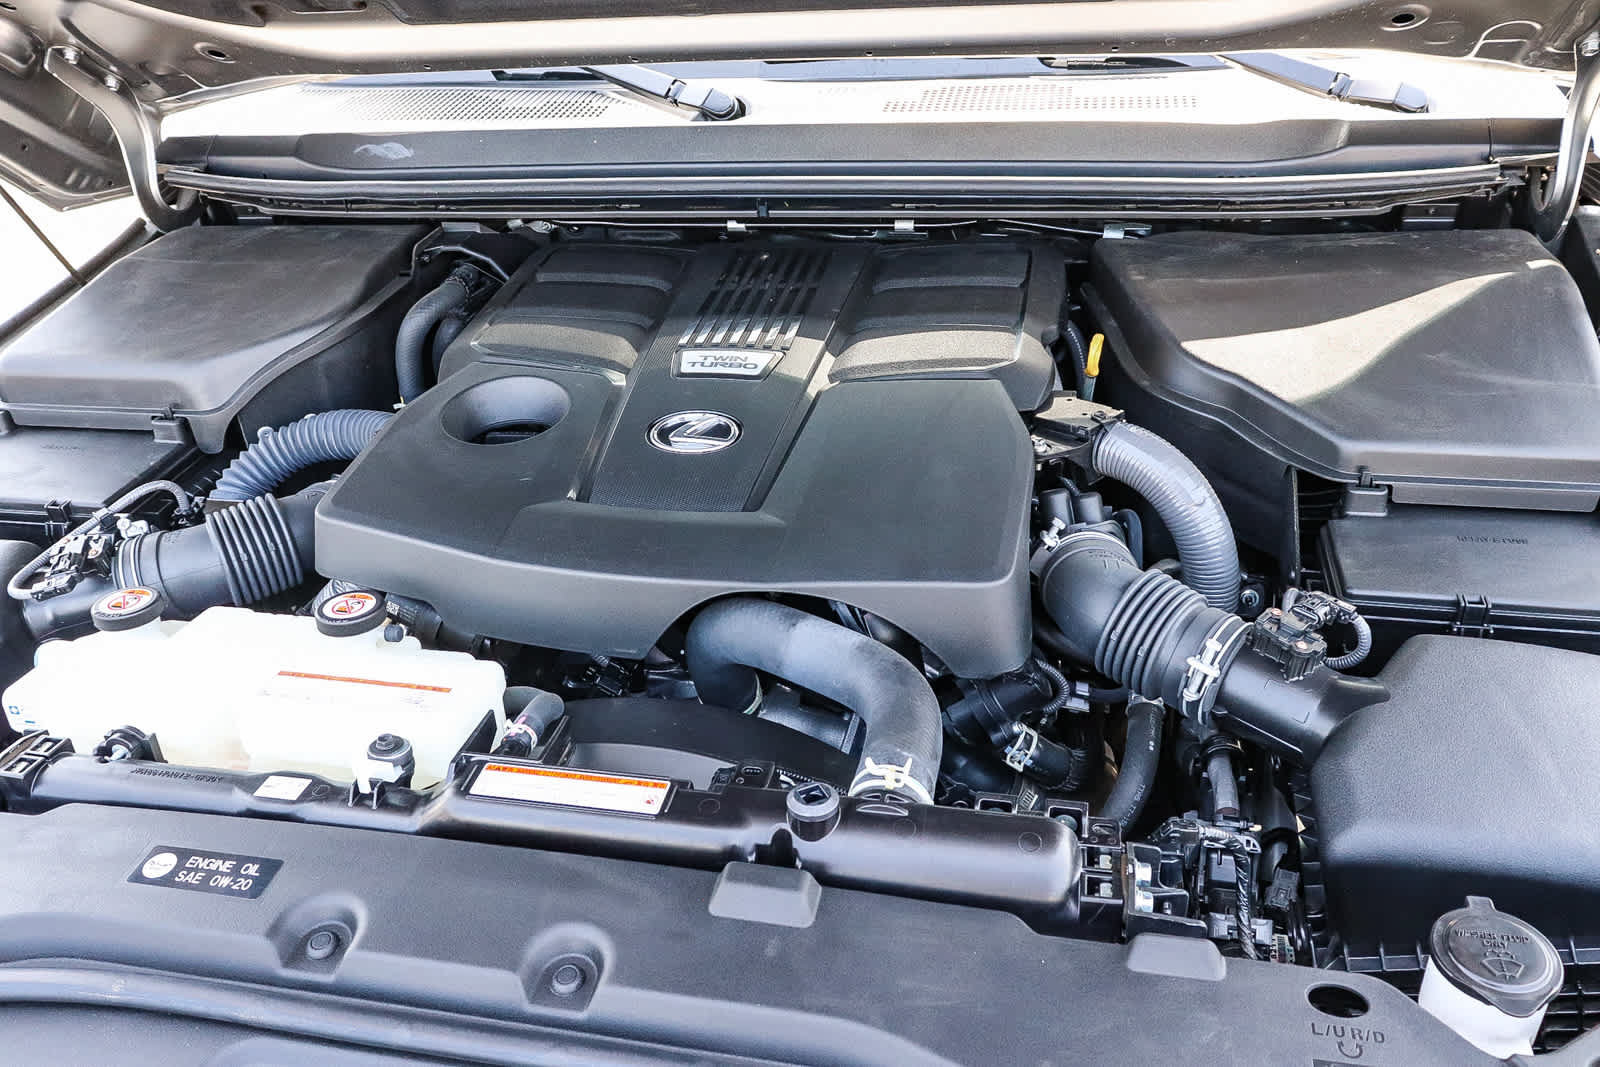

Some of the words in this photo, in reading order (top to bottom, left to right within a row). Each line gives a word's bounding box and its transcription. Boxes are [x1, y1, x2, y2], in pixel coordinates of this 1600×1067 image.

[687, 361, 759, 370] TURBO
[699, 354, 748, 363] TWIN
[185, 855, 236, 873] ENGINE
[240, 863, 260, 876] OIL
[174, 870, 206, 884] SAE
[209, 875, 253, 891] 0W-20
[1311, 1022, 1345, 1038] L/U
